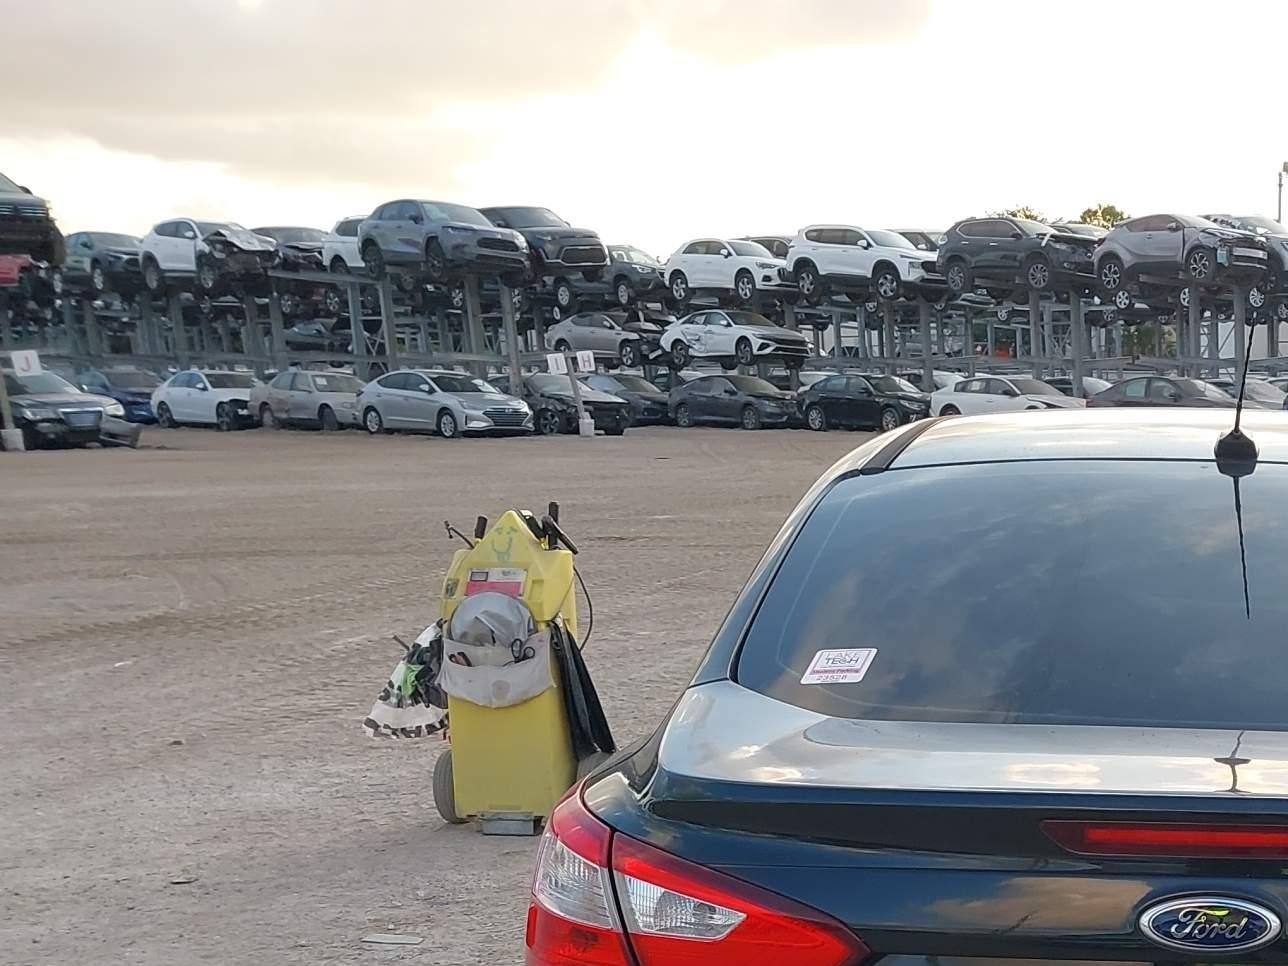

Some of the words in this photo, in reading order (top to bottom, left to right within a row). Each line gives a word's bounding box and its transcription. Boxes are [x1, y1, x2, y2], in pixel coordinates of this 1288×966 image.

[20, 356, 31, 372] J
[581, 354, 592, 369] H
[1170, 907, 1249, 939] Ford
